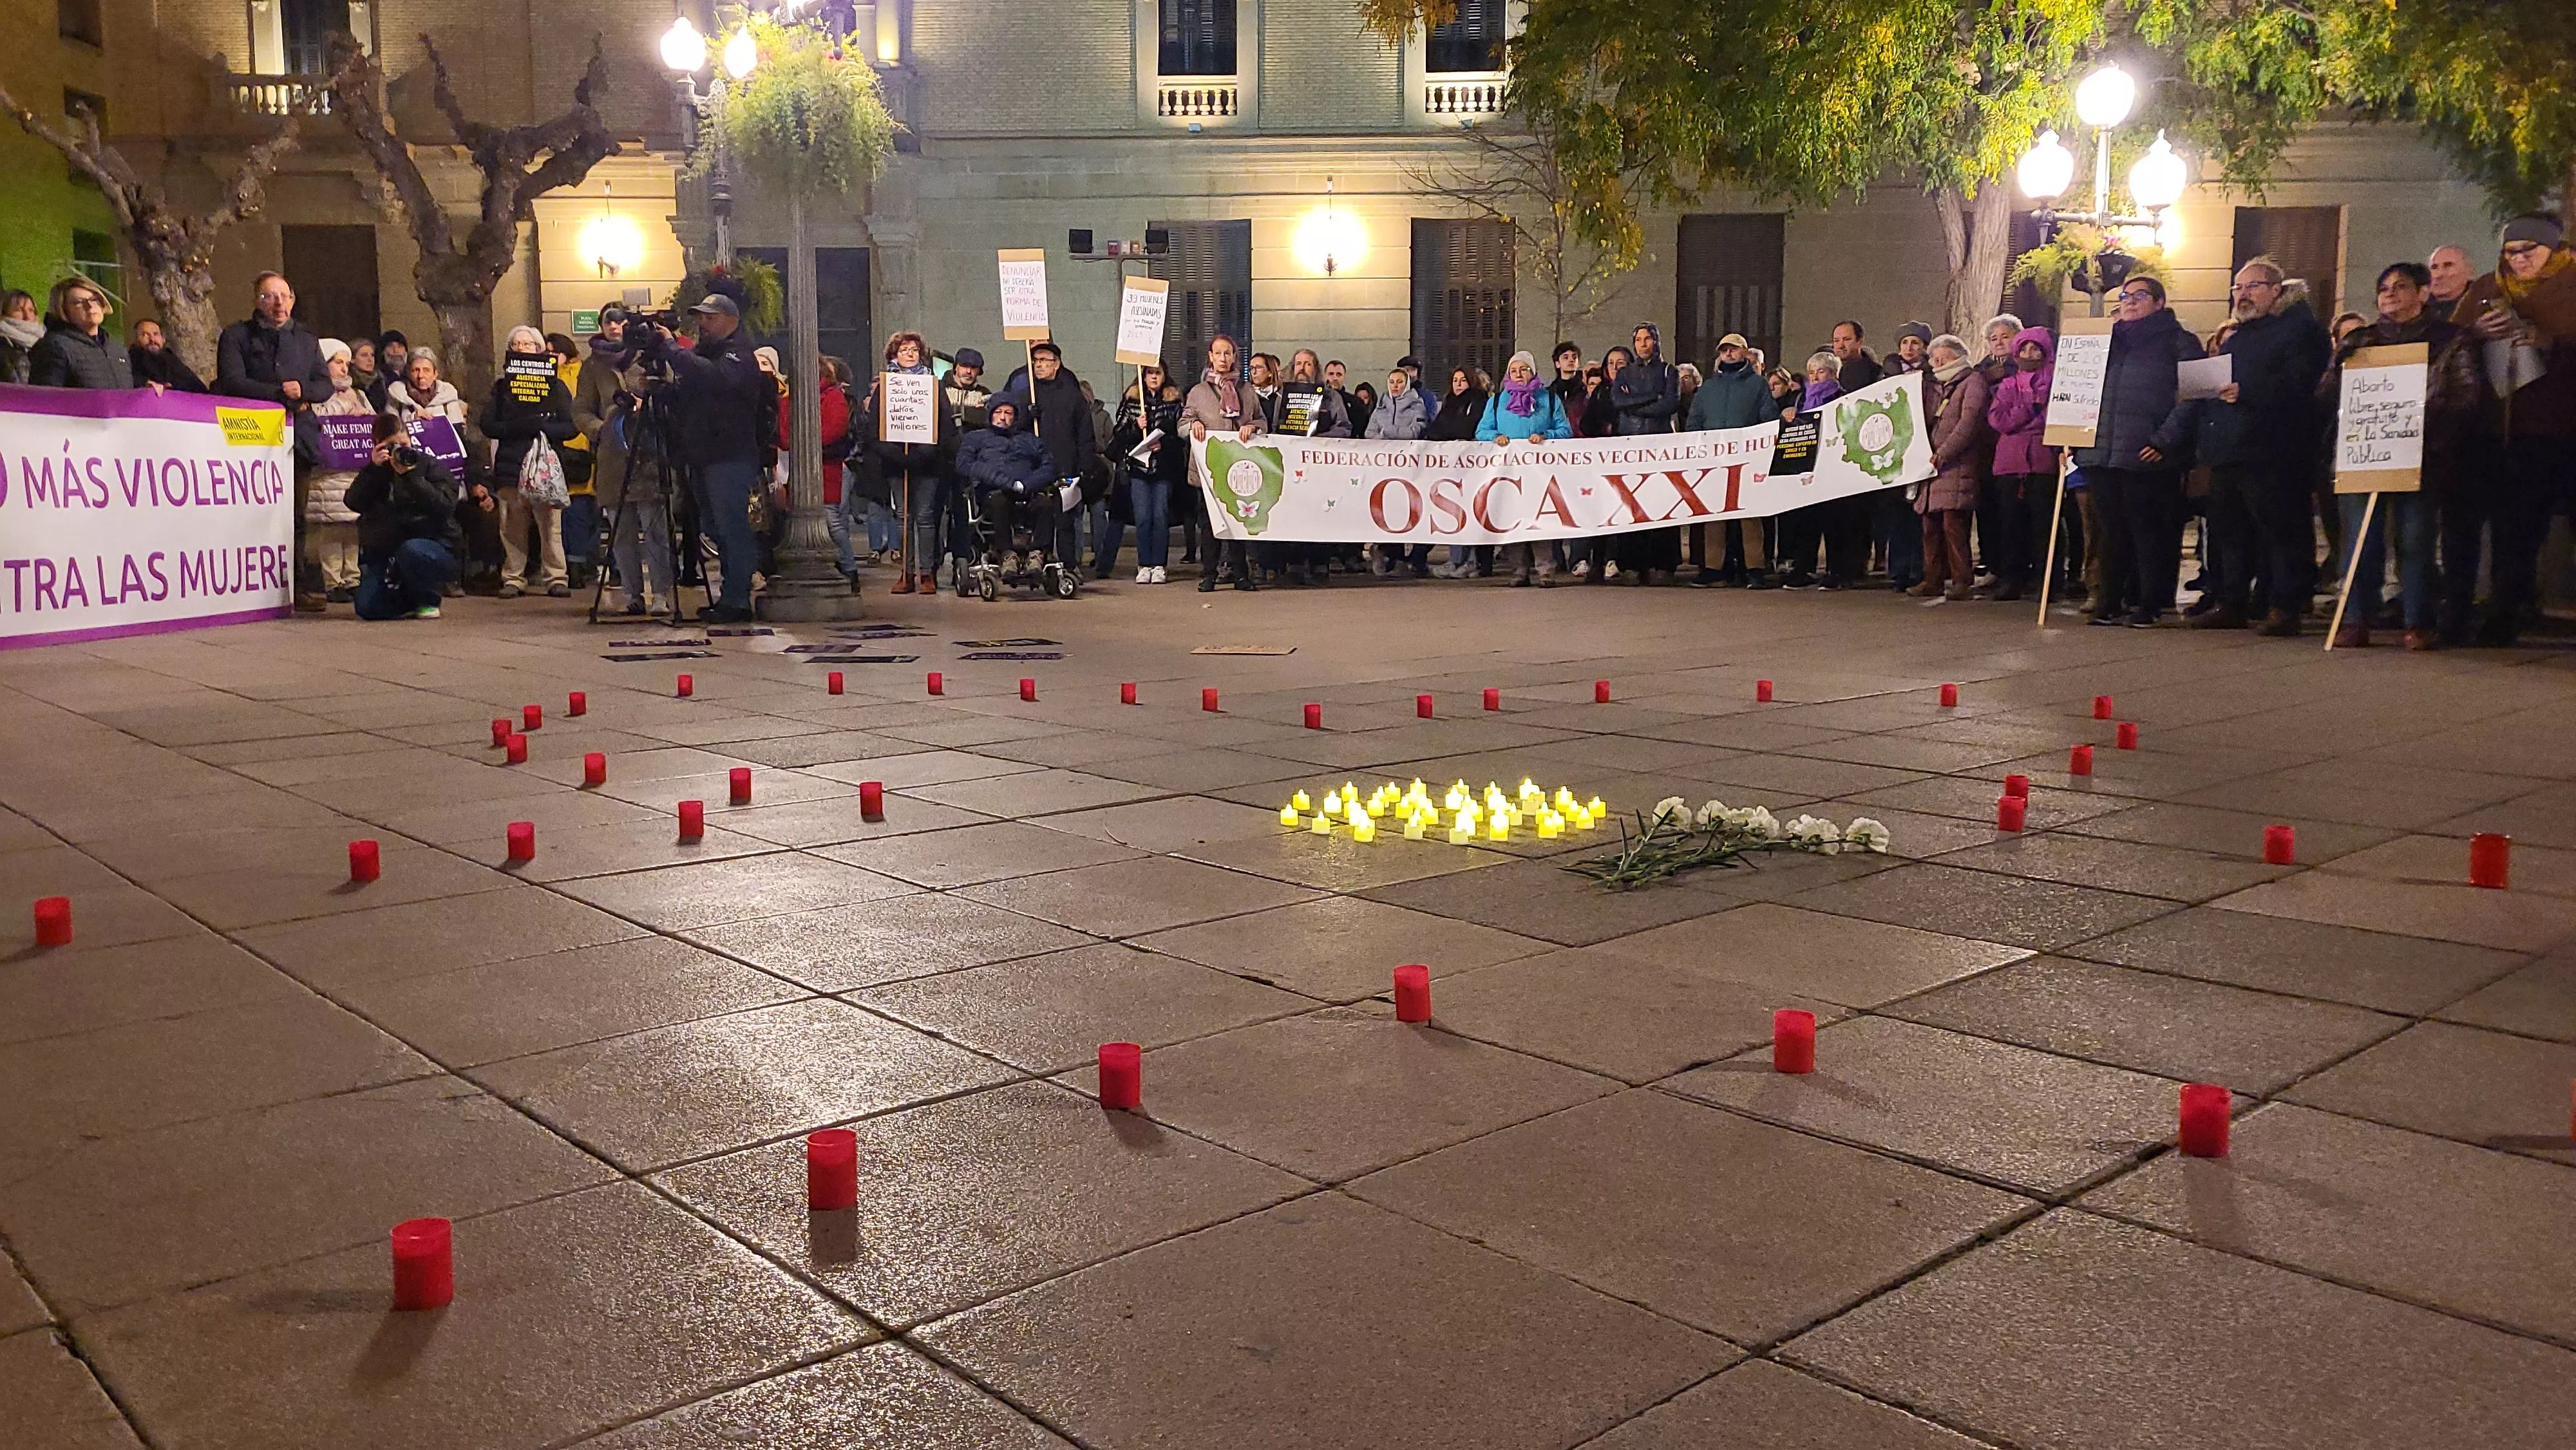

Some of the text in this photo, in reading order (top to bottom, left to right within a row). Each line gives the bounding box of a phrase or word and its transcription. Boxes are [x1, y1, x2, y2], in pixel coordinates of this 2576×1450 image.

[1033, 298, 1041, 306] DE
[1127, 294, 1137, 303] 39
[1007, 309, 1046, 321] VIOLENCIA
[889, 377, 903, 386] Se
[2351, 374, 2394, 393] Aborto
[222, 416, 261, 430] AMNISTÍA
[323, 424, 348, 435] MAKE
[891, 422, 927, 431] millones
[332, 438, 374, 449] GREAT AG
[1301, 449, 1420, 468] FEDERACIÓN
[1425, 454, 1449, 468] DE
[1454, 451, 1592, 469] ASOCIACIONES
[1598, 444, 1707, 464] VECINALES
[1712, 441, 1738, 457] DE
[21, 438, 109, 509] MÁS
[115, 458, 283, 508] VIOLENCIA
[1370, 462, 1750, 535] OSCA XXI
[0, 556, 89, 614] TRA
[97, 551, 169, 605] LAS
